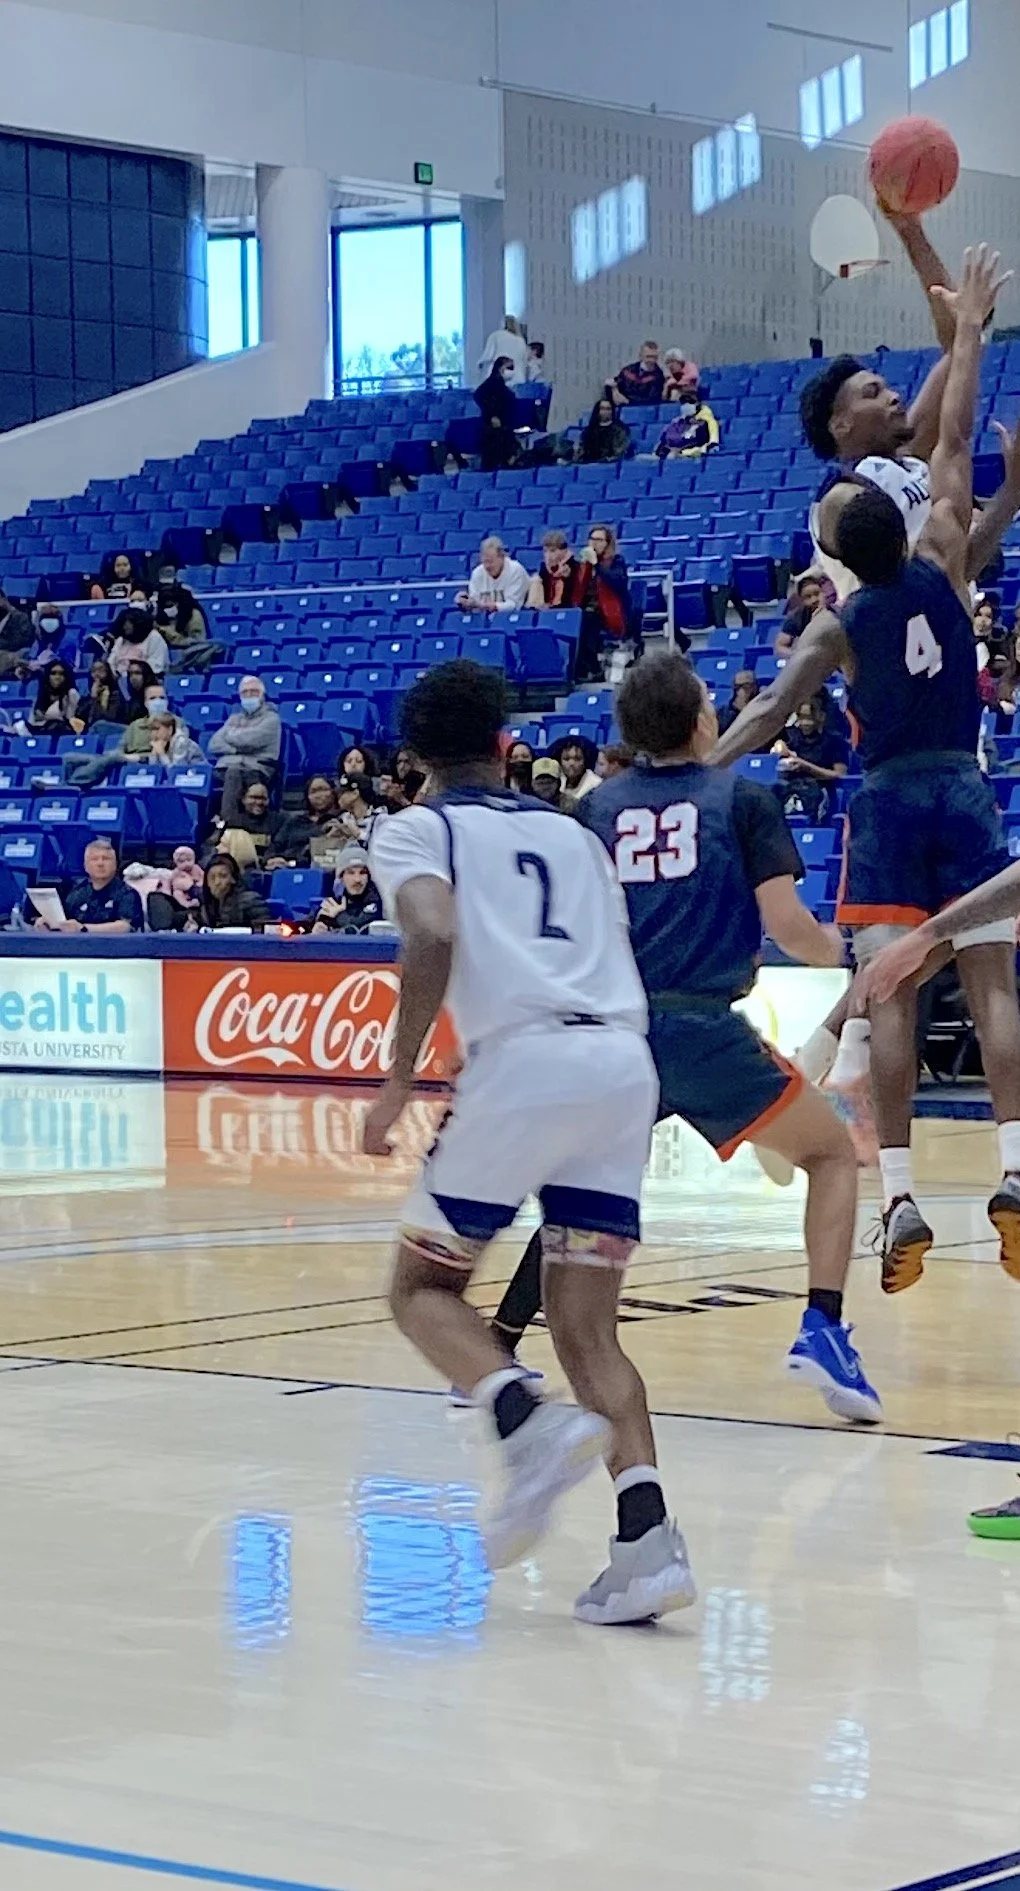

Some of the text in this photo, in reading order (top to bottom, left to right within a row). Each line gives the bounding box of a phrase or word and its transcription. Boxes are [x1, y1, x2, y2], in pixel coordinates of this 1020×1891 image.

[905, 613, 943, 679] 4
[614, 801, 699, 883] 23
[517, 852, 571, 940] 2
[0, 971, 126, 1034] ealth
[0, 1040, 126, 1060] STA UNIVERSITY
